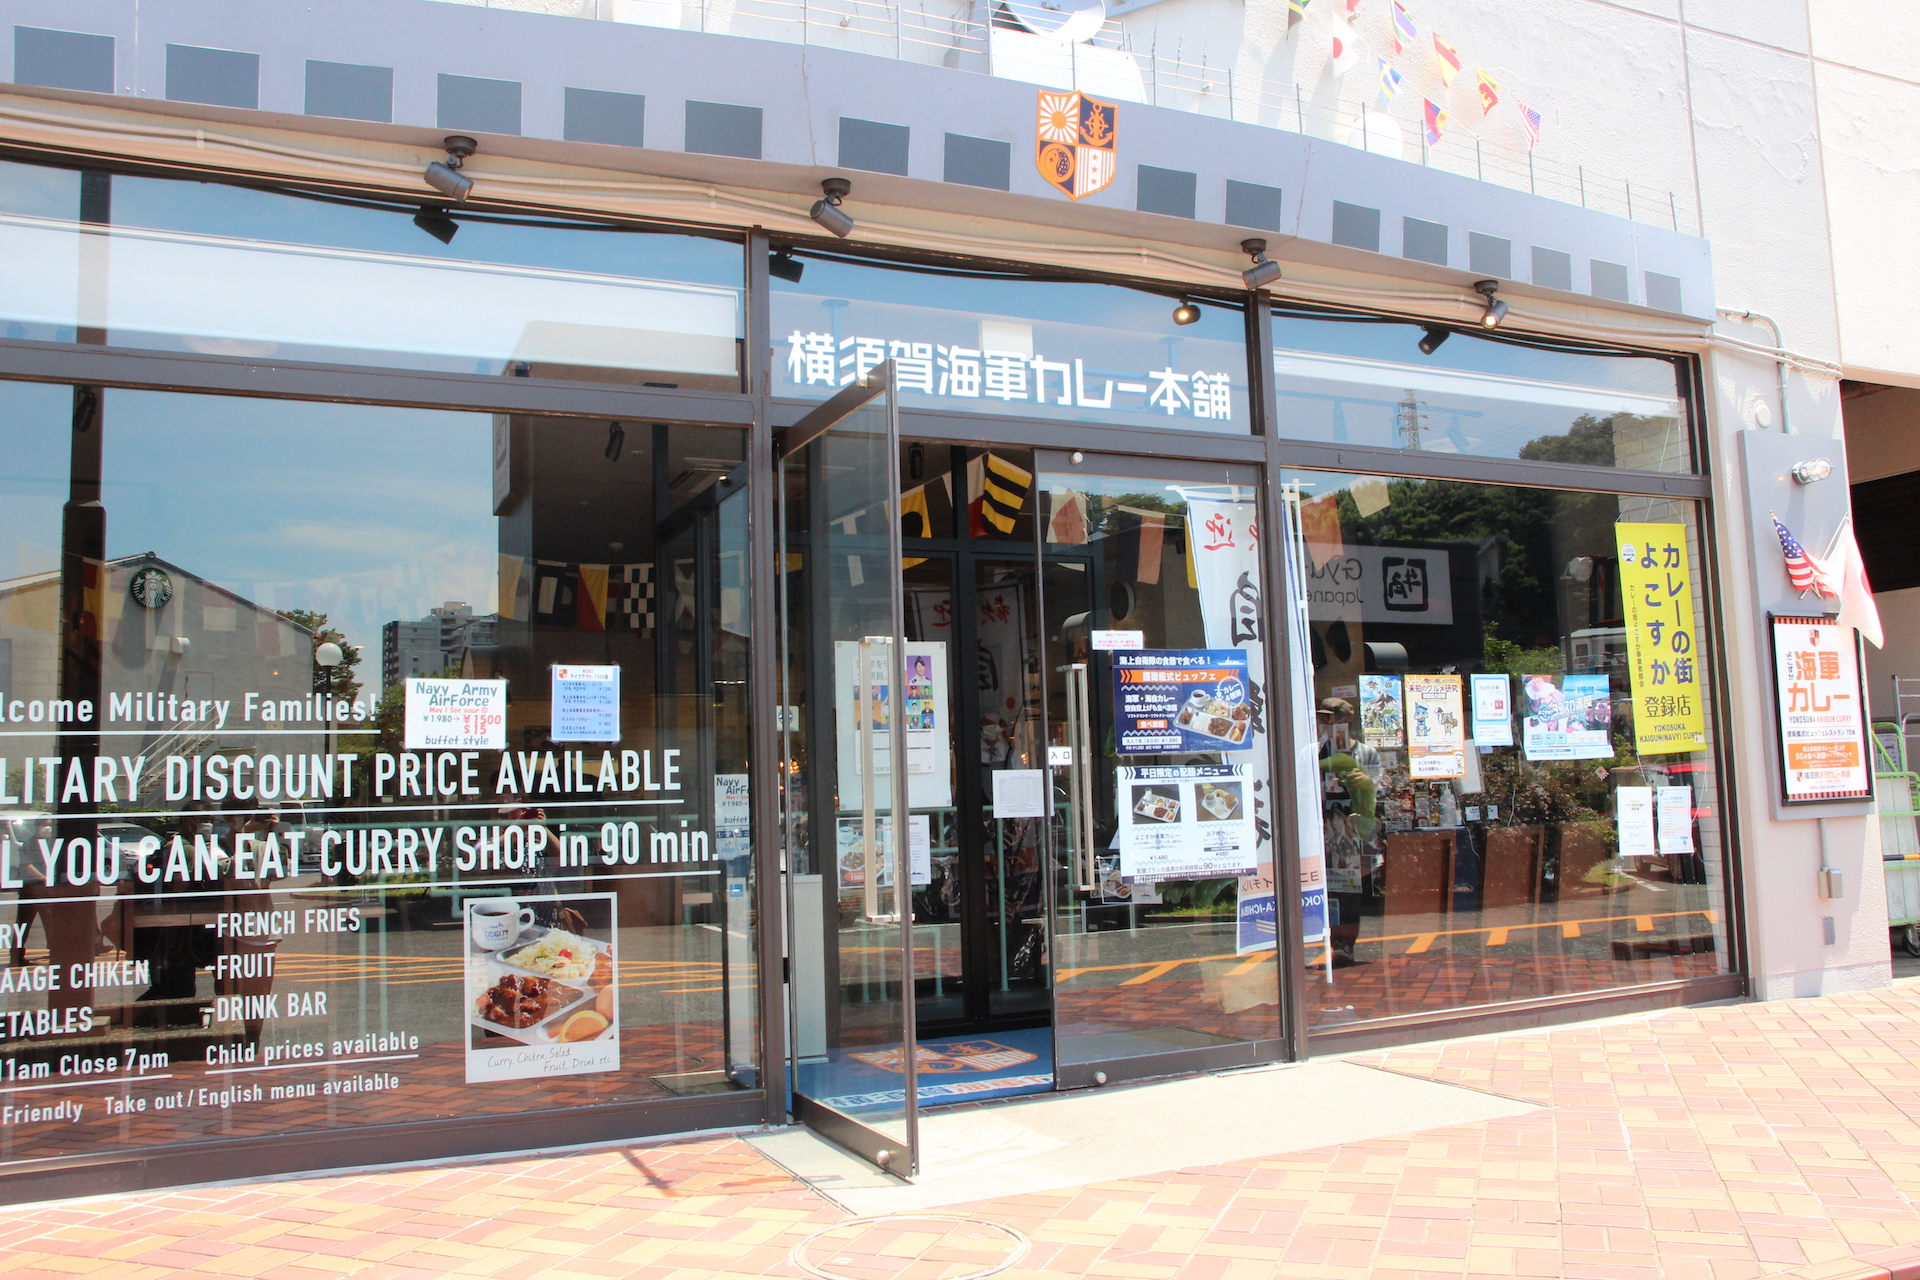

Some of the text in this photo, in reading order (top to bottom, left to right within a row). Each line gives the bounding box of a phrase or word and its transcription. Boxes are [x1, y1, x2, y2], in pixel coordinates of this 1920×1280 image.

[787, 330, 1232, 421] 横須賀海軍カレー本舗
[1640, 542, 1671, 686] よこすか
[1662, 542, 1693, 685] カレーの街
[1794, 650, 1841, 681] 海軍
[416, 681, 498, 697] Navy Army
[1787, 683, 1850, 713] カレー
[110, 691, 231, 729] Military
[244, 692, 377, 722] Families!
[429, 706, 443, 714] May
[464, 707, 480, 715] your
[1644, 694, 1691, 718] 登録店
[425, 735, 489, 747] buffet style
[1653, 723, 1686, 732] YOKOSUKA
[1050, 750, 1071, 761] 入口
[165, 753, 358, 803] DISCOUNT
[374, 752, 481, 798] PRICE
[495, 748, 682, 795] AVAILABLE
[716, 777, 740, 787] Navy
[38, 836, 121, 888] YOU
[138, 833, 220, 885] CAN
[235, 830, 306, 880] EAT
[320, 827, 445, 877] CURRY
[455, 824, 549, 873] SHOP
[560, 819, 590, 868] in
[600, 821, 641, 867] 90
[650, 819, 720, 864] min.
[304, 907, 361, 934] FRIES
[0, 959, 149, 994] AAGE CHIKEN
[287, 991, 328, 1017] BAR
[59, 1054, 118, 1077] Close
[125, 1048, 169, 1075] 7pm
[205, 1030, 419, 1067] Child prices available
[487, 1055, 515, 1069] Curry,
[549, 1047, 571, 1059] Salad
[543, 1061, 568, 1073] Fruit,
[572, 1057, 596, 1068] Drink
[105, 1095, 146, 1116] Take
[270, 1082, 316, 1100] menu
[323, 1072, 400, 1095] available
[2, 1099, 84, 1126] Friendly
